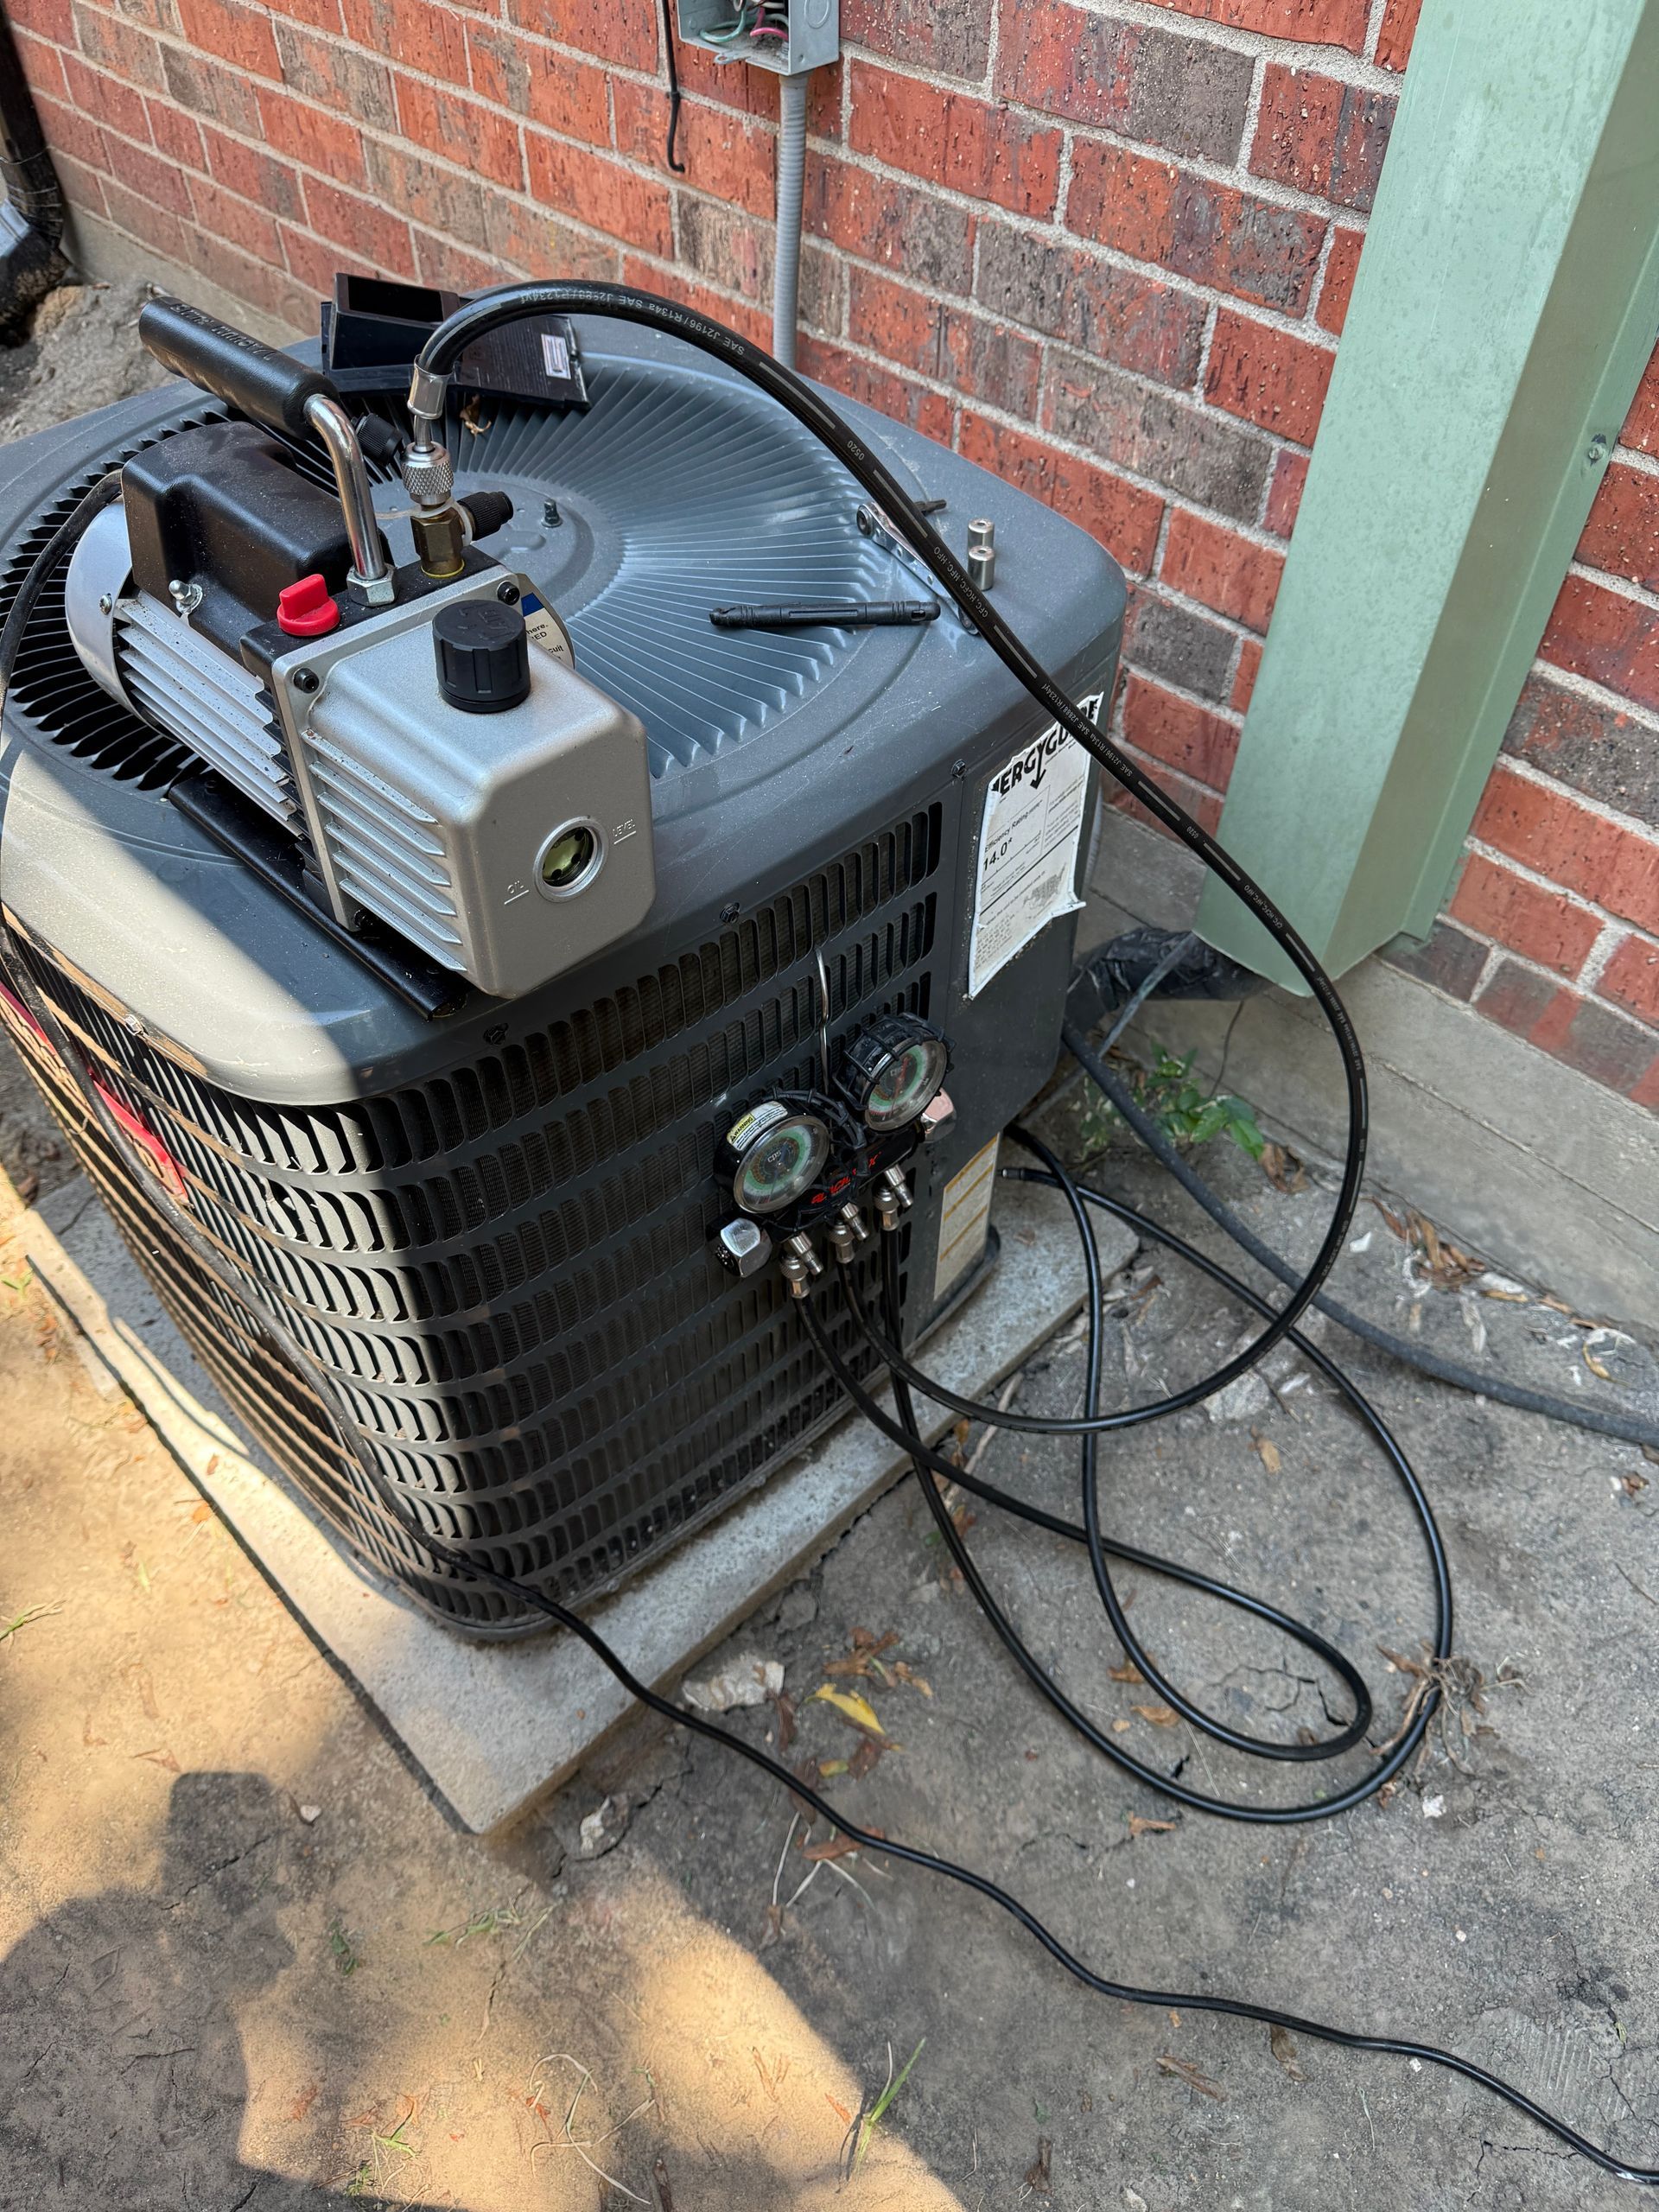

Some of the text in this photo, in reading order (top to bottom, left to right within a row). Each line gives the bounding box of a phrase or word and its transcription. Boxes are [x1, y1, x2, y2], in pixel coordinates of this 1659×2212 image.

[619, 295, 643, 309] SAE
[723, 336, 745, 356] SAE
[847, 440, 865, 461] 0520
[1077, 721, 1090, 735] SAE
[1120, 763, 1134, 777] SAE
[612, 818, 636, 837] LEVEL
[506, 880, 525, 895] OIL
[734, 1116, 753, 1136] WARNING
